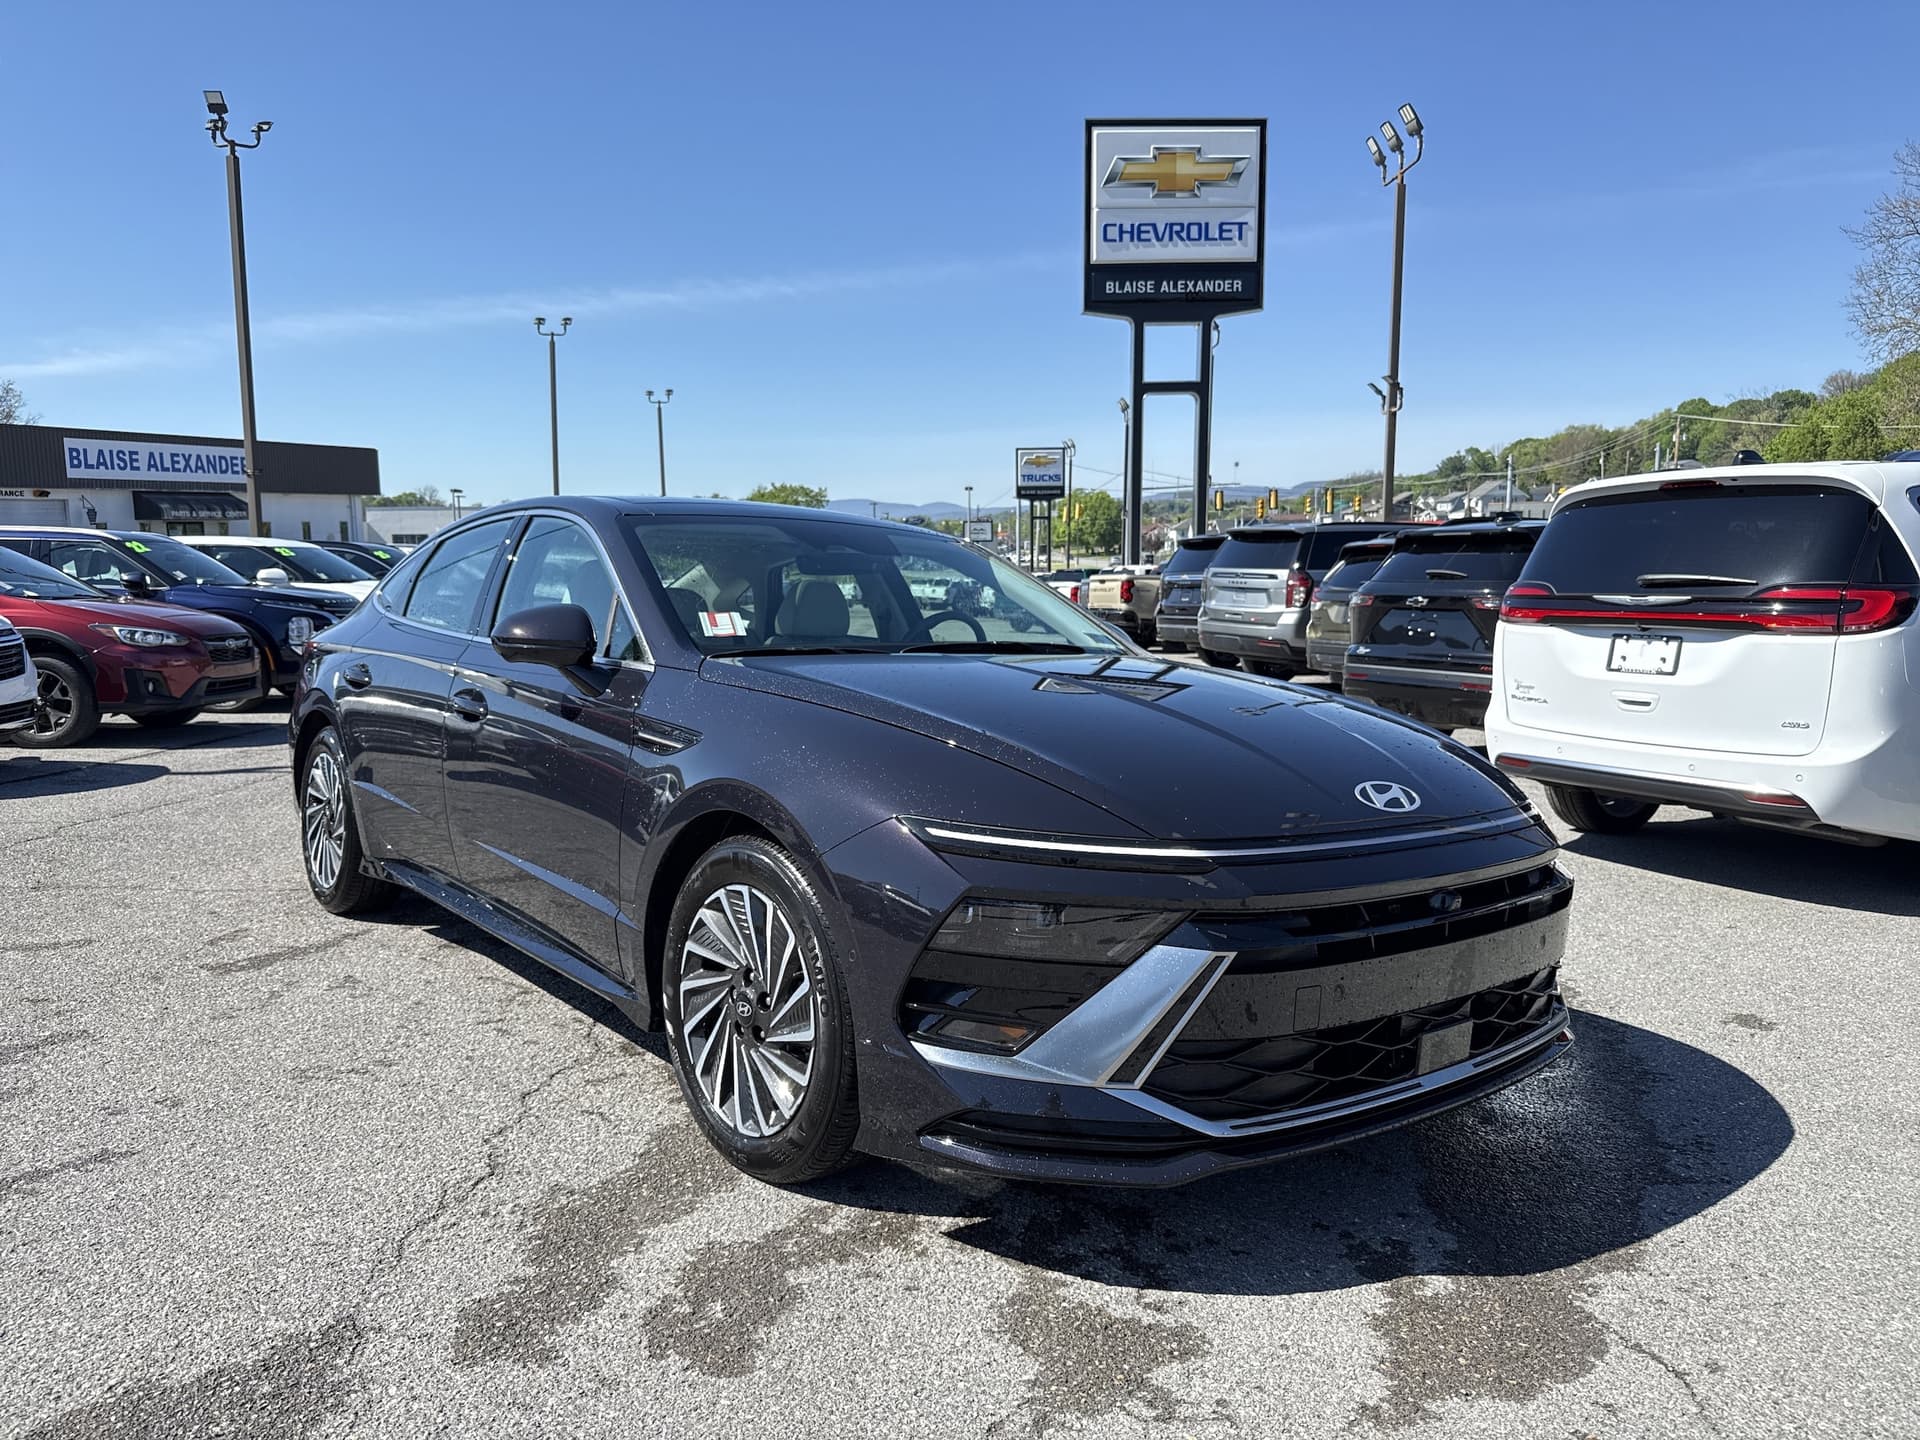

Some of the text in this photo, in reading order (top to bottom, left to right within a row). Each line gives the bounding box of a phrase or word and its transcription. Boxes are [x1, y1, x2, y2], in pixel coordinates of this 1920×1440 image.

[1102, 221, 1249, 243] CHEVROLET
[1105, 279, 1243, 294] BLAISE ALEXANDER
[67, 447, 141, 472] BLAISE
[1021, 473, 1062, 483] TRUCKS
